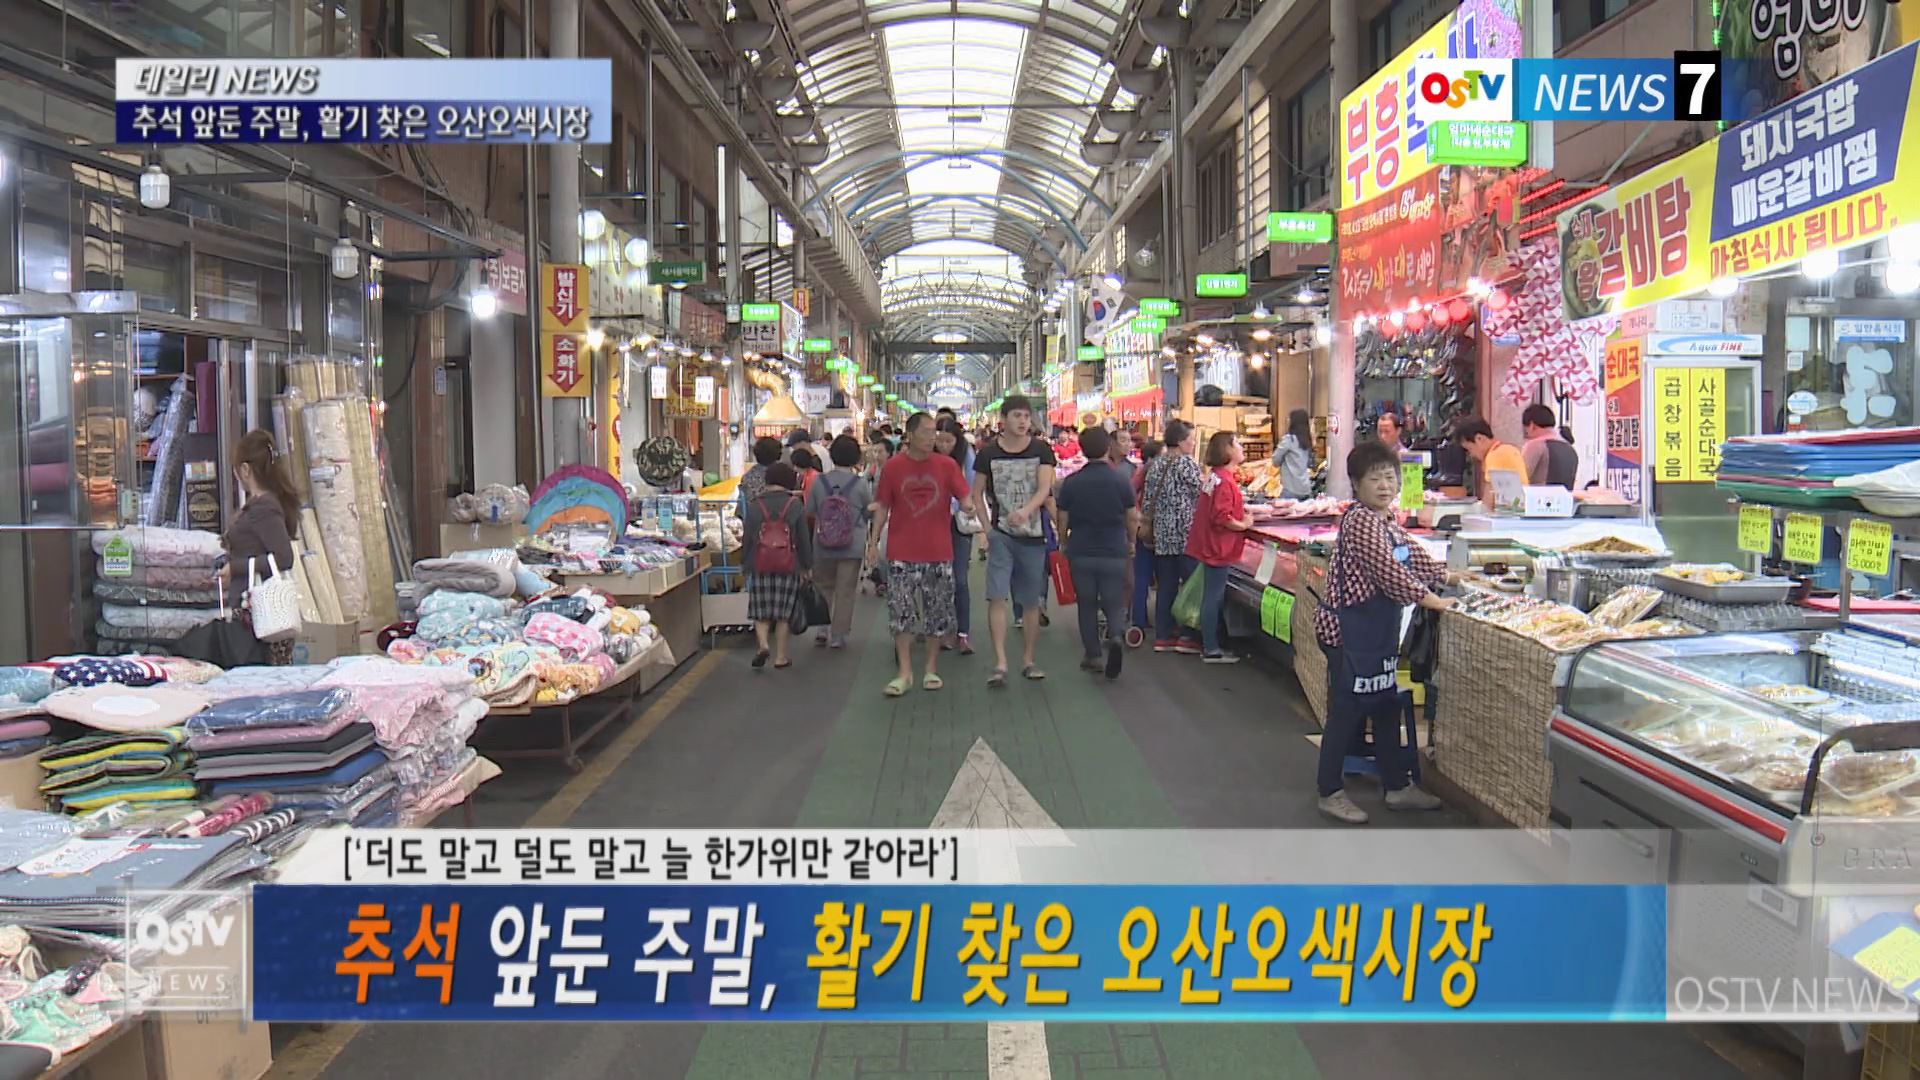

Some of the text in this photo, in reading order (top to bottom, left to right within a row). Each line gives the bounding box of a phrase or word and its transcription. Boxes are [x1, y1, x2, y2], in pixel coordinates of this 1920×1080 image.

[1740, 79, 1859, 172] 돼지국밥
[1731, 128, 1878, 227] 매운갈비찜
[1710, 192, 1897, 281] 아침식사 됩니다.
[557, 271, 576, 319] 발신기
[742, 323, 777, 342] 반찬
[557, 338, 576, 385] 소화기
[1606, 346, 1640, 379] 순대국
[1663, 375, 1682, 478] 곱창볶음
[1697, 376, 1718, 477] 사골순대국
